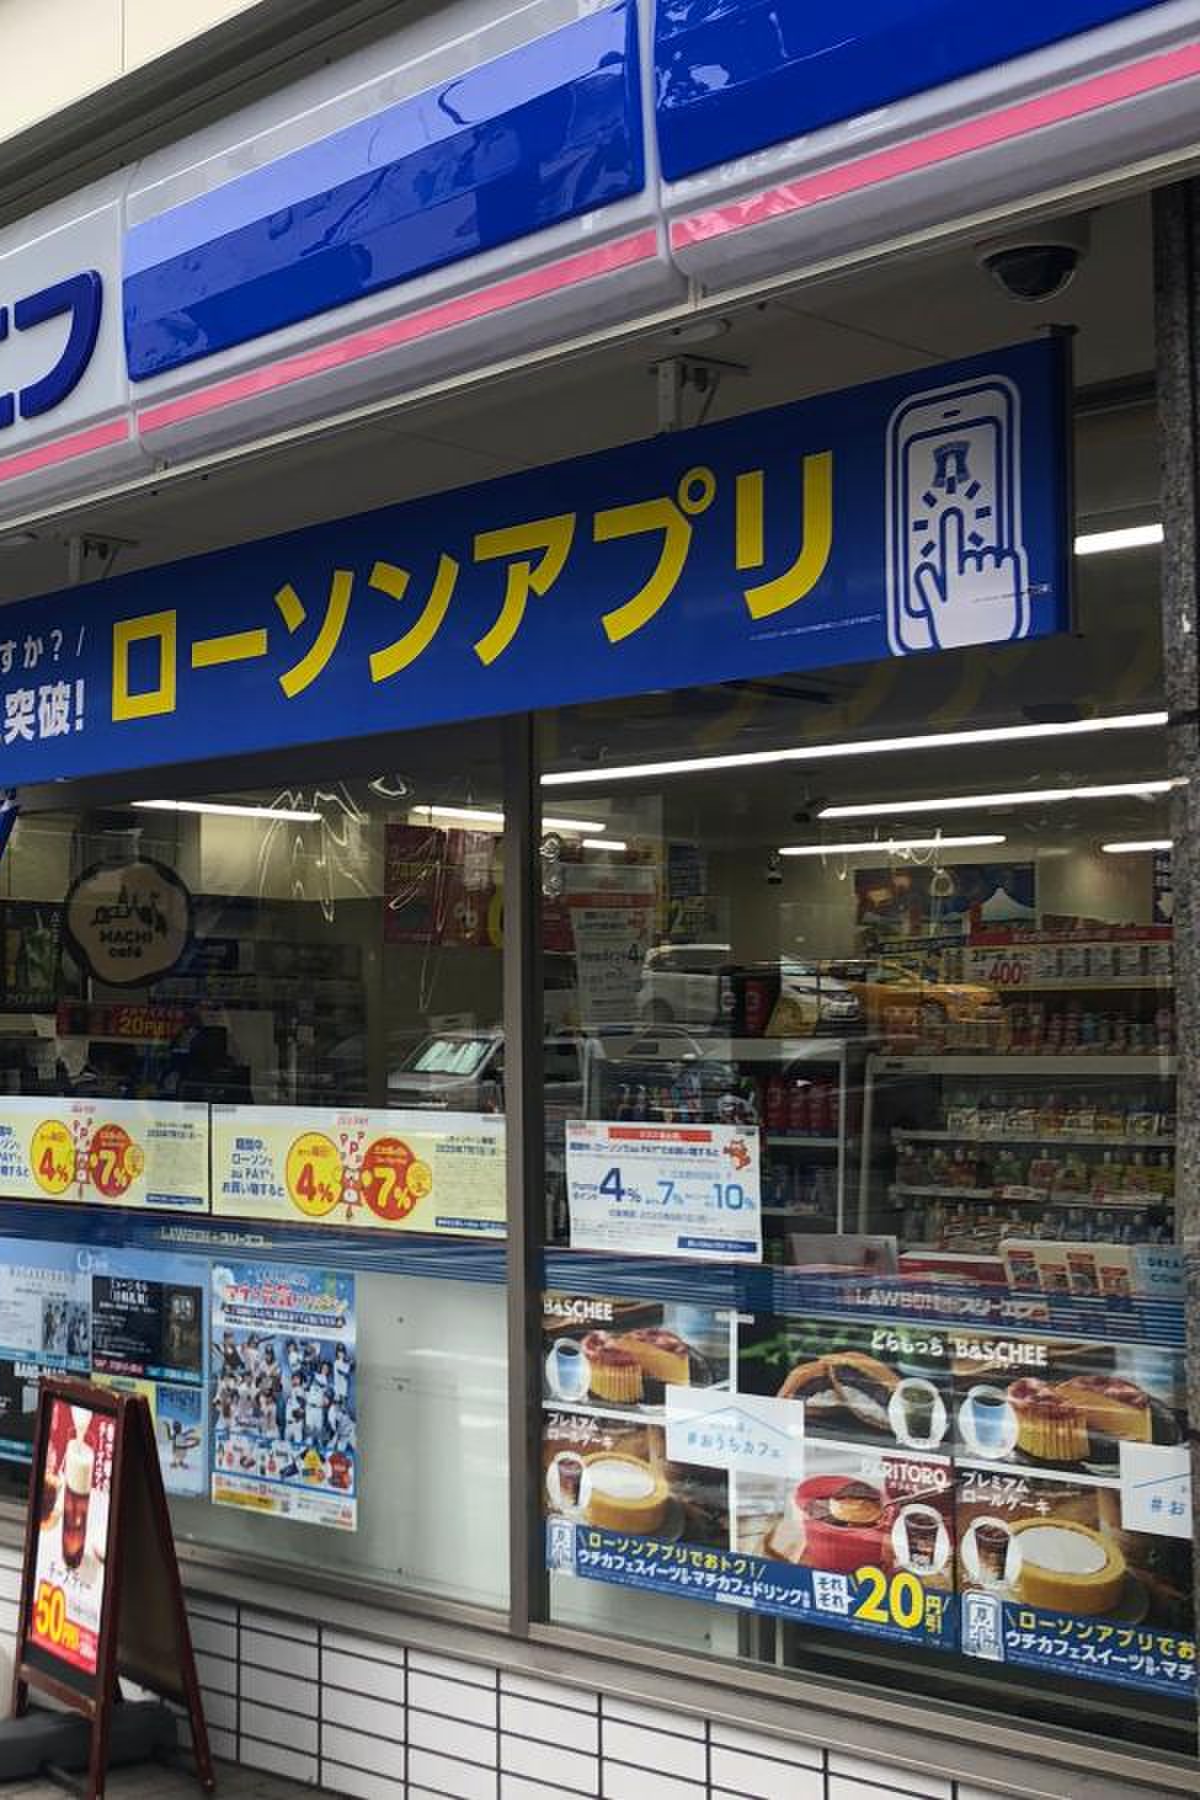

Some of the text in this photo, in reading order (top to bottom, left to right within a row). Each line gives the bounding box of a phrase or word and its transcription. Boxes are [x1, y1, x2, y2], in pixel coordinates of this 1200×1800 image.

[111, 449, 833, 721] ローソンアプリ
[39, 1147, 69, 1184] 4%
[99, 1149, 128, 1186] 7%
[296, 1163, 333, 1203] 4%
[599, 1167, 641, 1202] 4%
[374, 1166, 411, 1209] 7%
